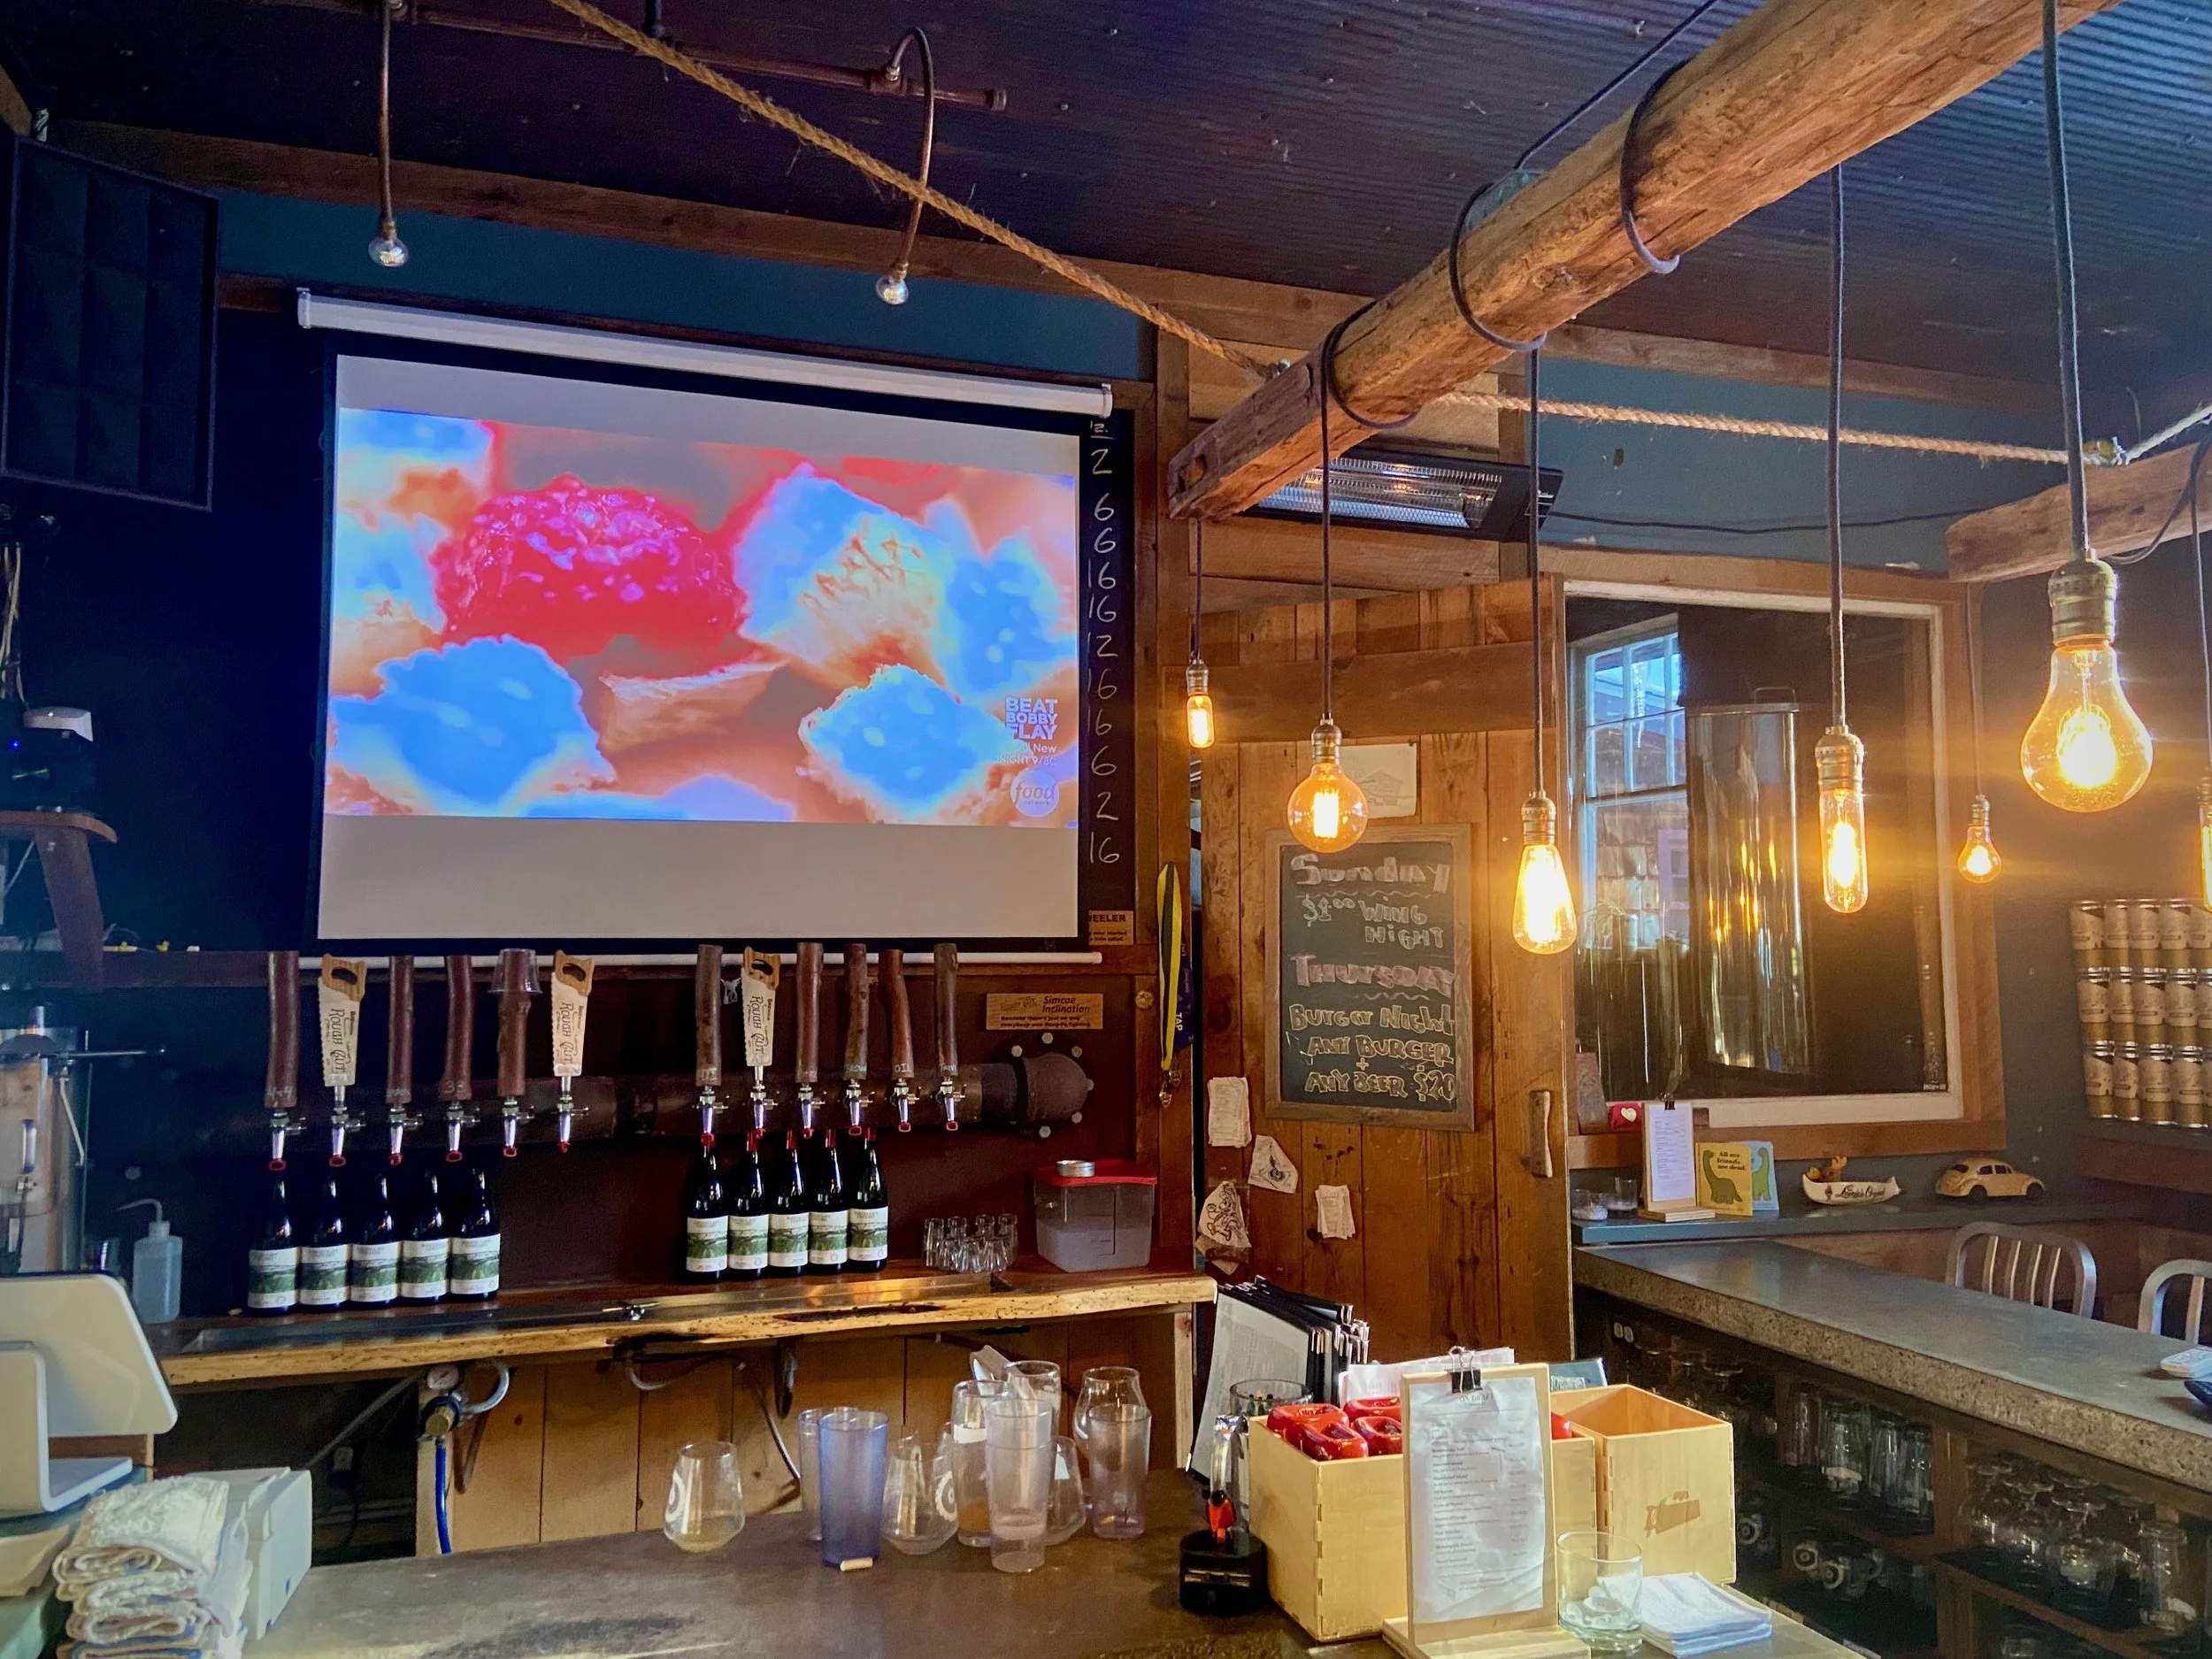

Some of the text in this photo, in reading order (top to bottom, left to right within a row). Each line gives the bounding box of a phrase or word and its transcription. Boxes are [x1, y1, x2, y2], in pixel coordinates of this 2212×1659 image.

[1091, 449, 1112, 474] 2
[1094, 493, 1115, 521] 6
[1094, 527, 1117, 554] 6
[1087, 558, 1117, 589] 16
[1088, 594, 1117, 622] 16
[1087, 632, 1118, 657] 12
[1087, 668, 1118, 700] 16
[1005, 696, 1058, 713] BEAT
[1005, 711, 1058, 725] BOBBY
[1087, 705, 1112, 735] 16
[1033, 743, 1057, 753] New
[1092, 746, 1117, 776] 6
[1015, 780, 1055, 804] food
[1096, 791, 1118, 821] 2
[1089, 831, 1119, 864] 16
[1043, 995, 1077, 1005] Simcoe
[329, 1009, 345, 1045] ROUGH
[1174, 1012, 1183, 1032] TAP
